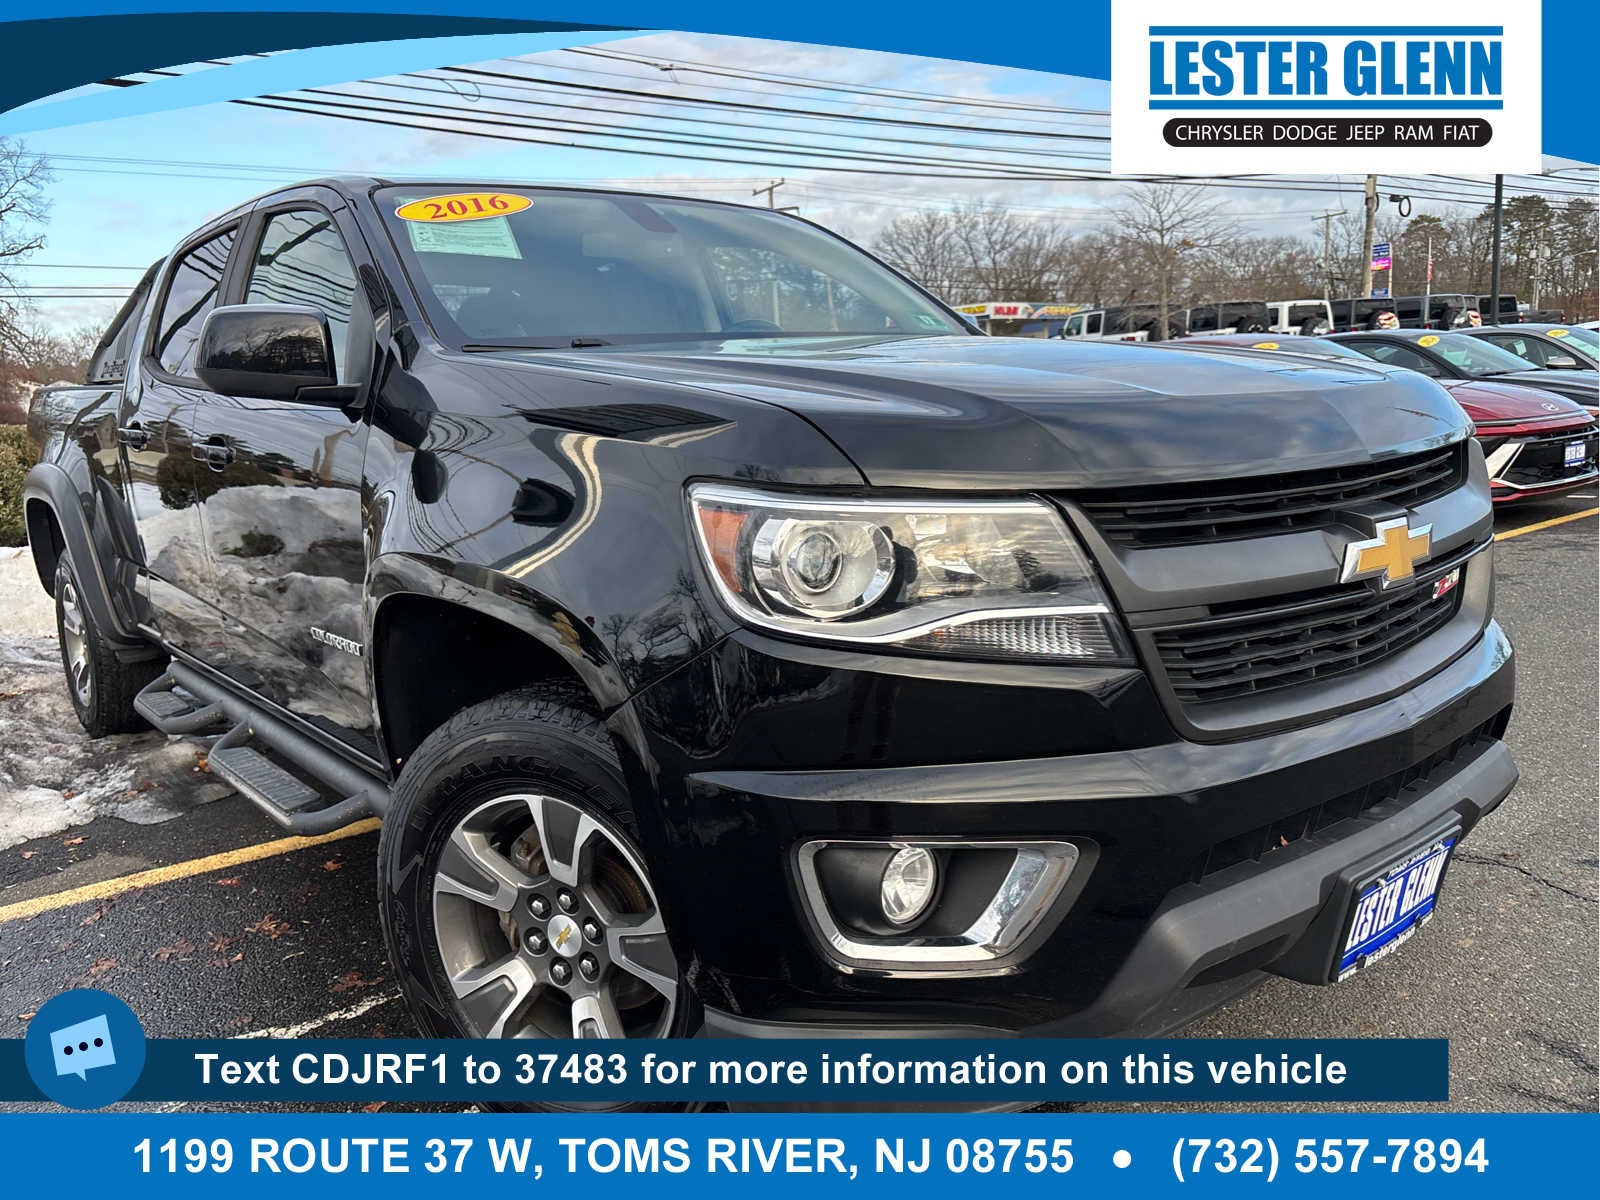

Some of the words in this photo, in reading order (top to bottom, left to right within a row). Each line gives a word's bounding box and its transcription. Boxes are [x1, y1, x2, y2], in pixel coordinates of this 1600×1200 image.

[423, 195, 510, 219] 2016
[1344, 876, 1405, 952] LESTER
[1399, 849, 1450, 917] GLENN
